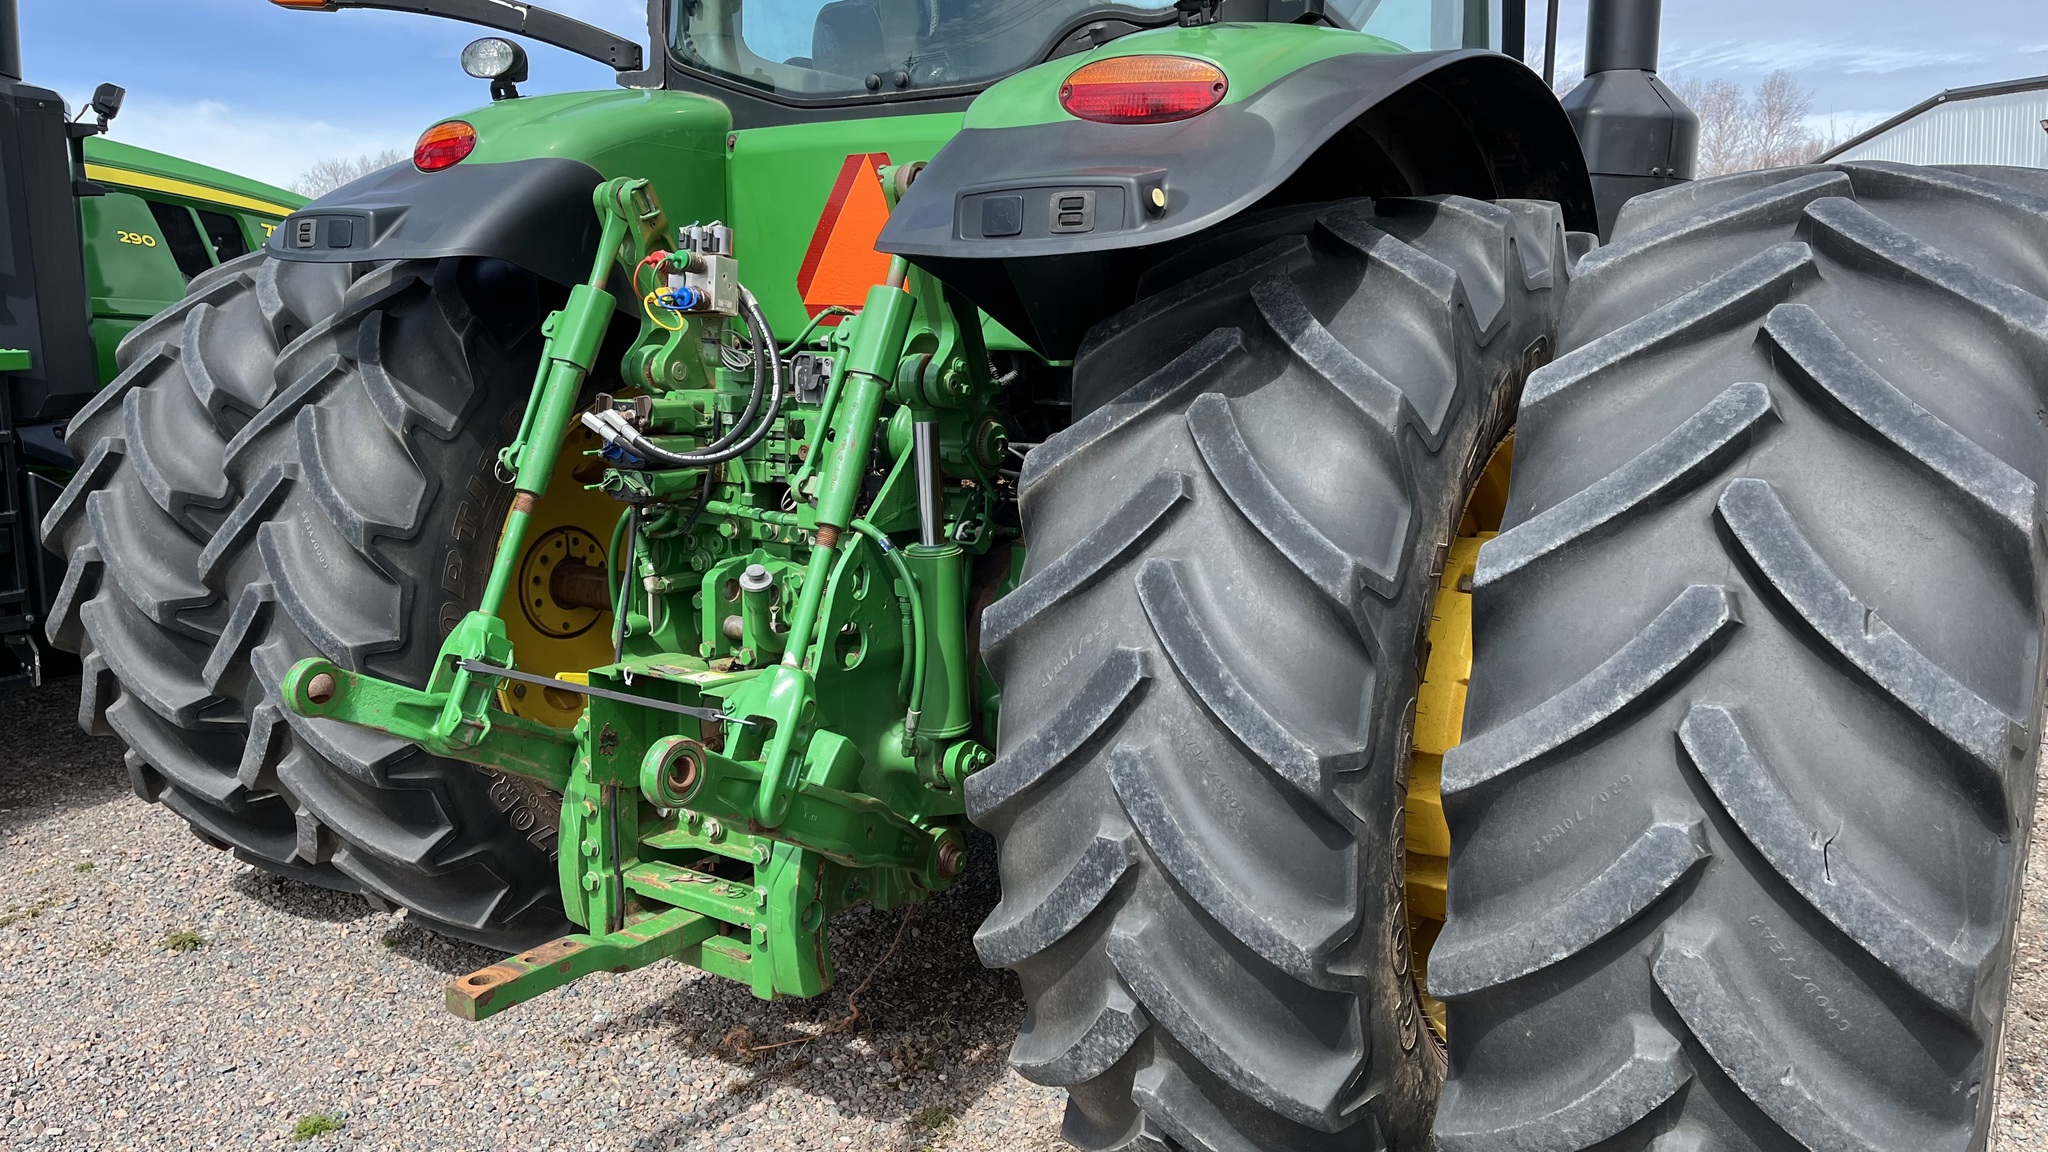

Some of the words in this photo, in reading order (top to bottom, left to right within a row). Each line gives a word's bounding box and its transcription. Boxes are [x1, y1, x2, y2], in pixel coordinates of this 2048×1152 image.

[116, 230, 157, 247] 290
[260, 222, 278, 239] 7
[1178, 726, 1247, 820] GOODYEAR
[1529, 773, 1633, 855] 620/70R42
[1746, 913, 1852, 1031] GOODYEAR
